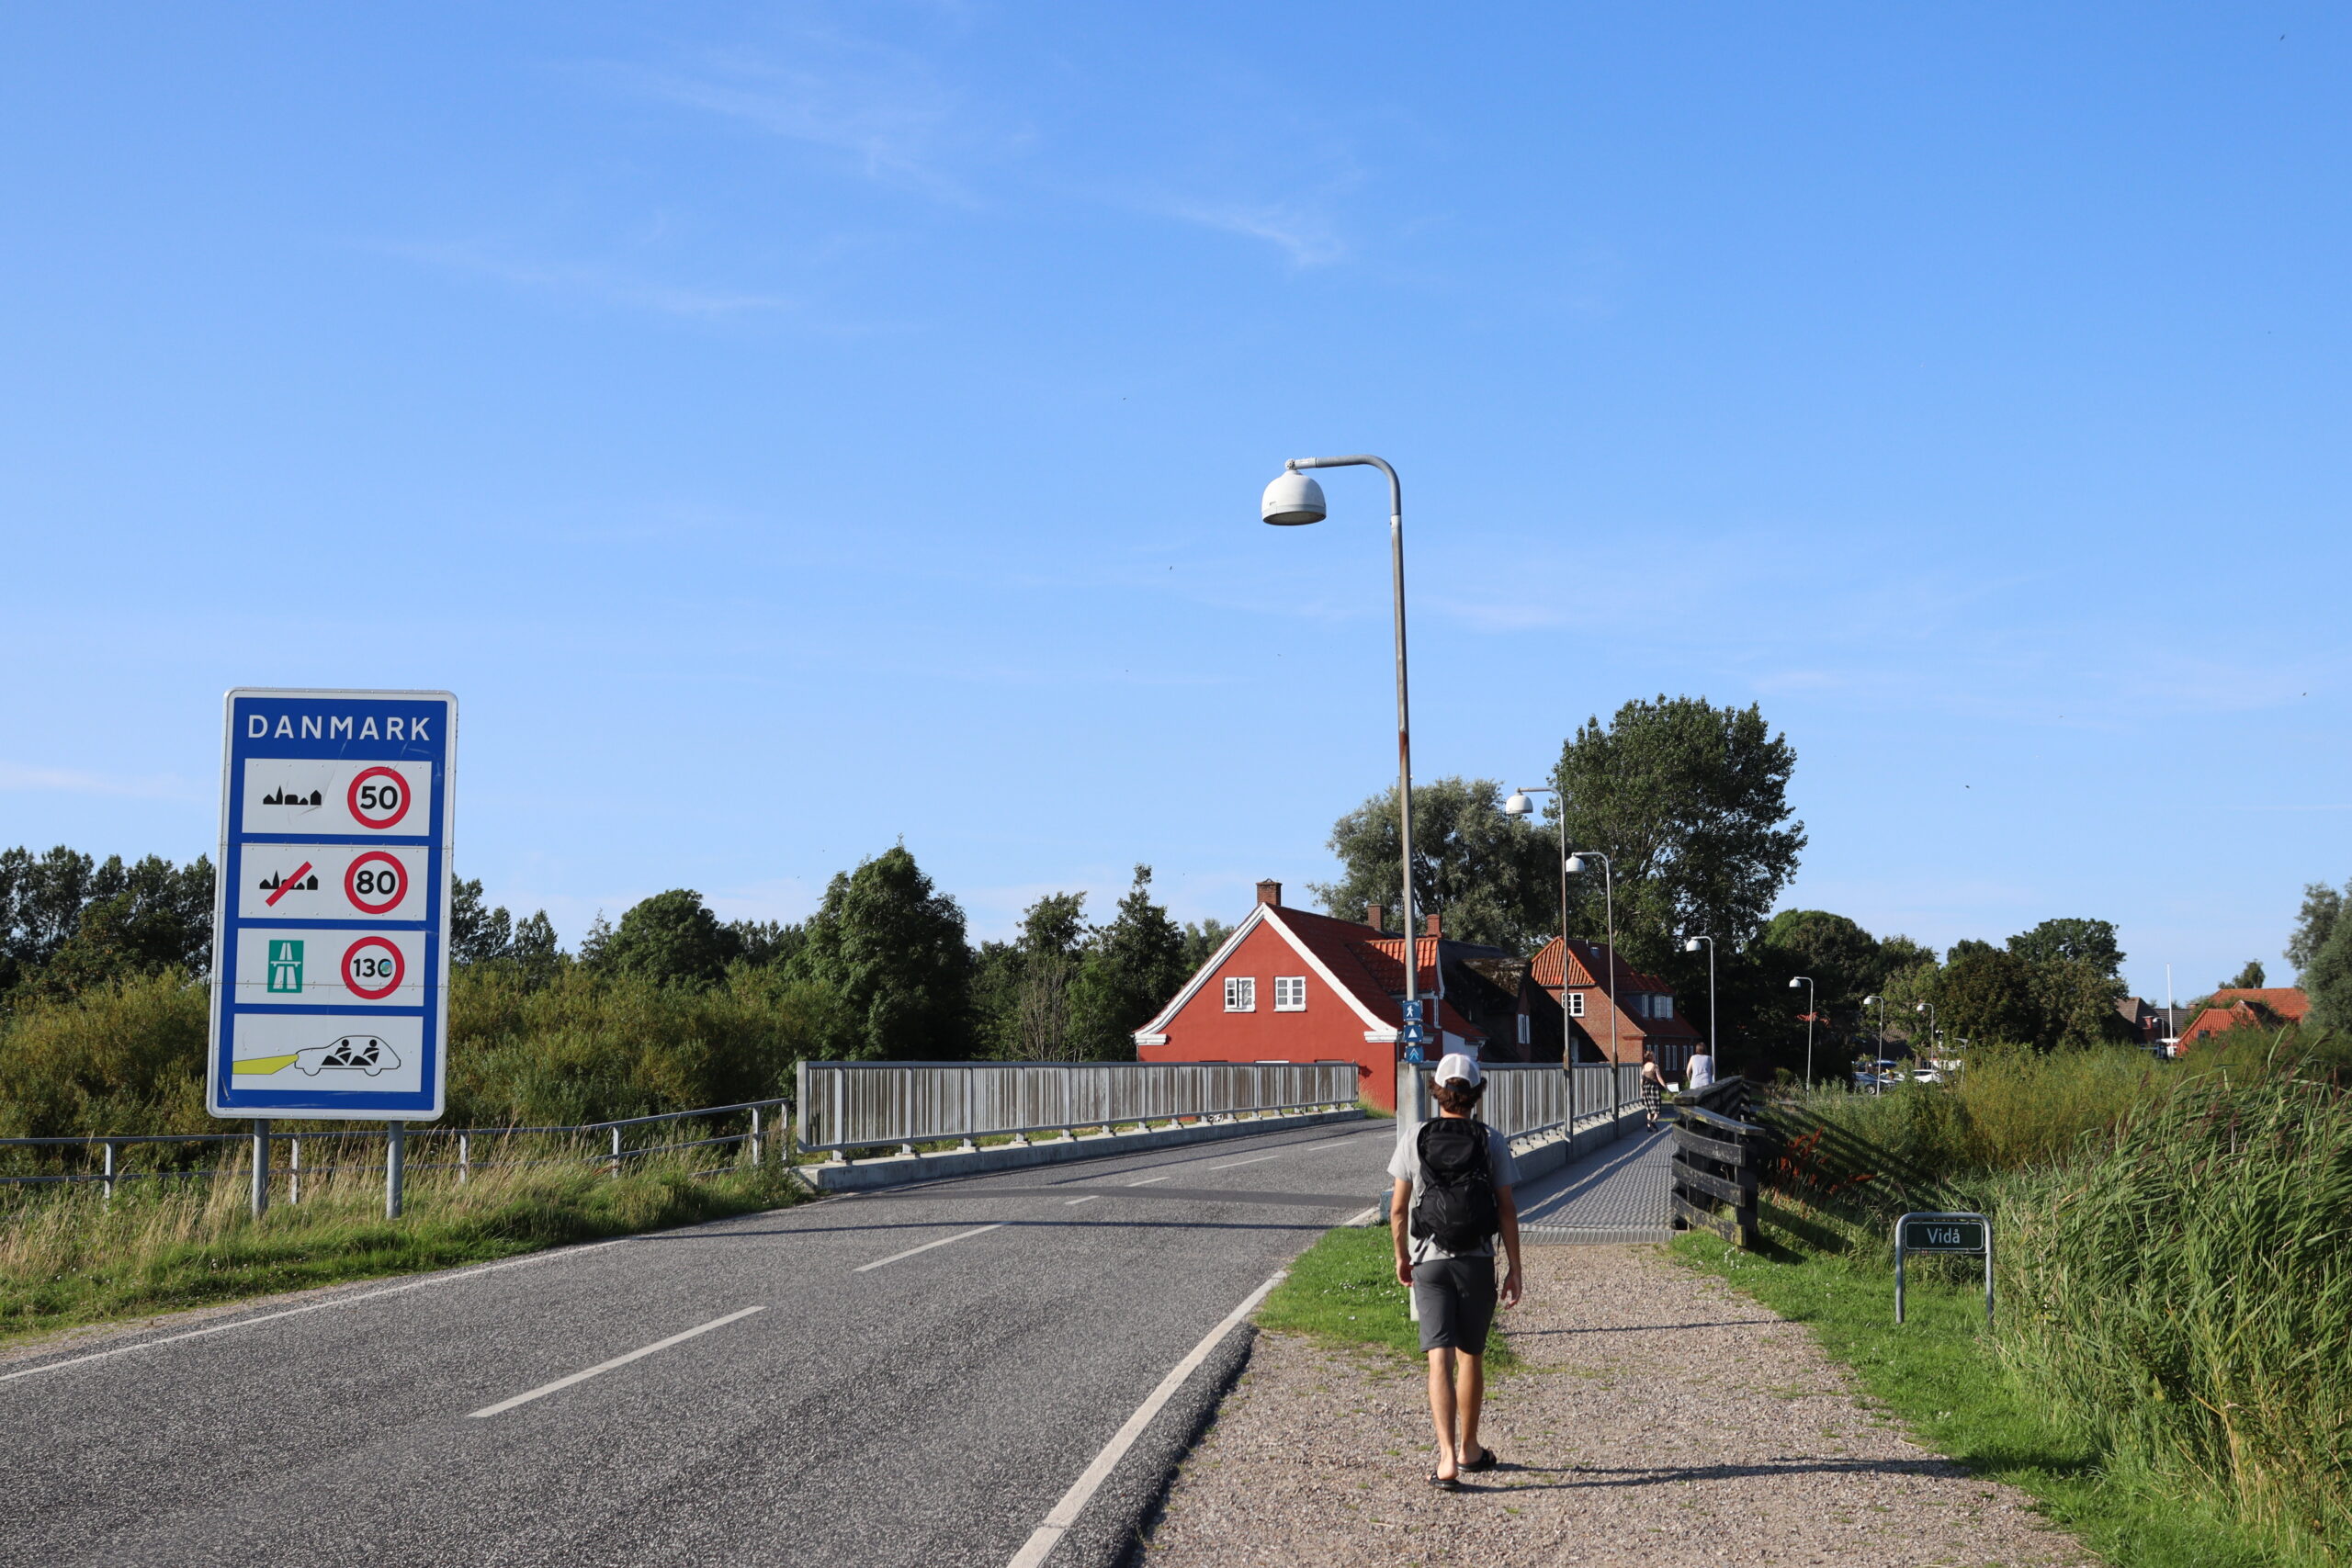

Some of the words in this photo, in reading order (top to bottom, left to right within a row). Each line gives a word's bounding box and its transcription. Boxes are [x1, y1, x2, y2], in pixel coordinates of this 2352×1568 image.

[248, 715, 430, 741] DANMARK
[360, 785, 398, 810] 50
[356, 870, 396, 895] 80
[353, 958, 393, 978] 130
[1927, 1227, 1961, 1245] Vidå
